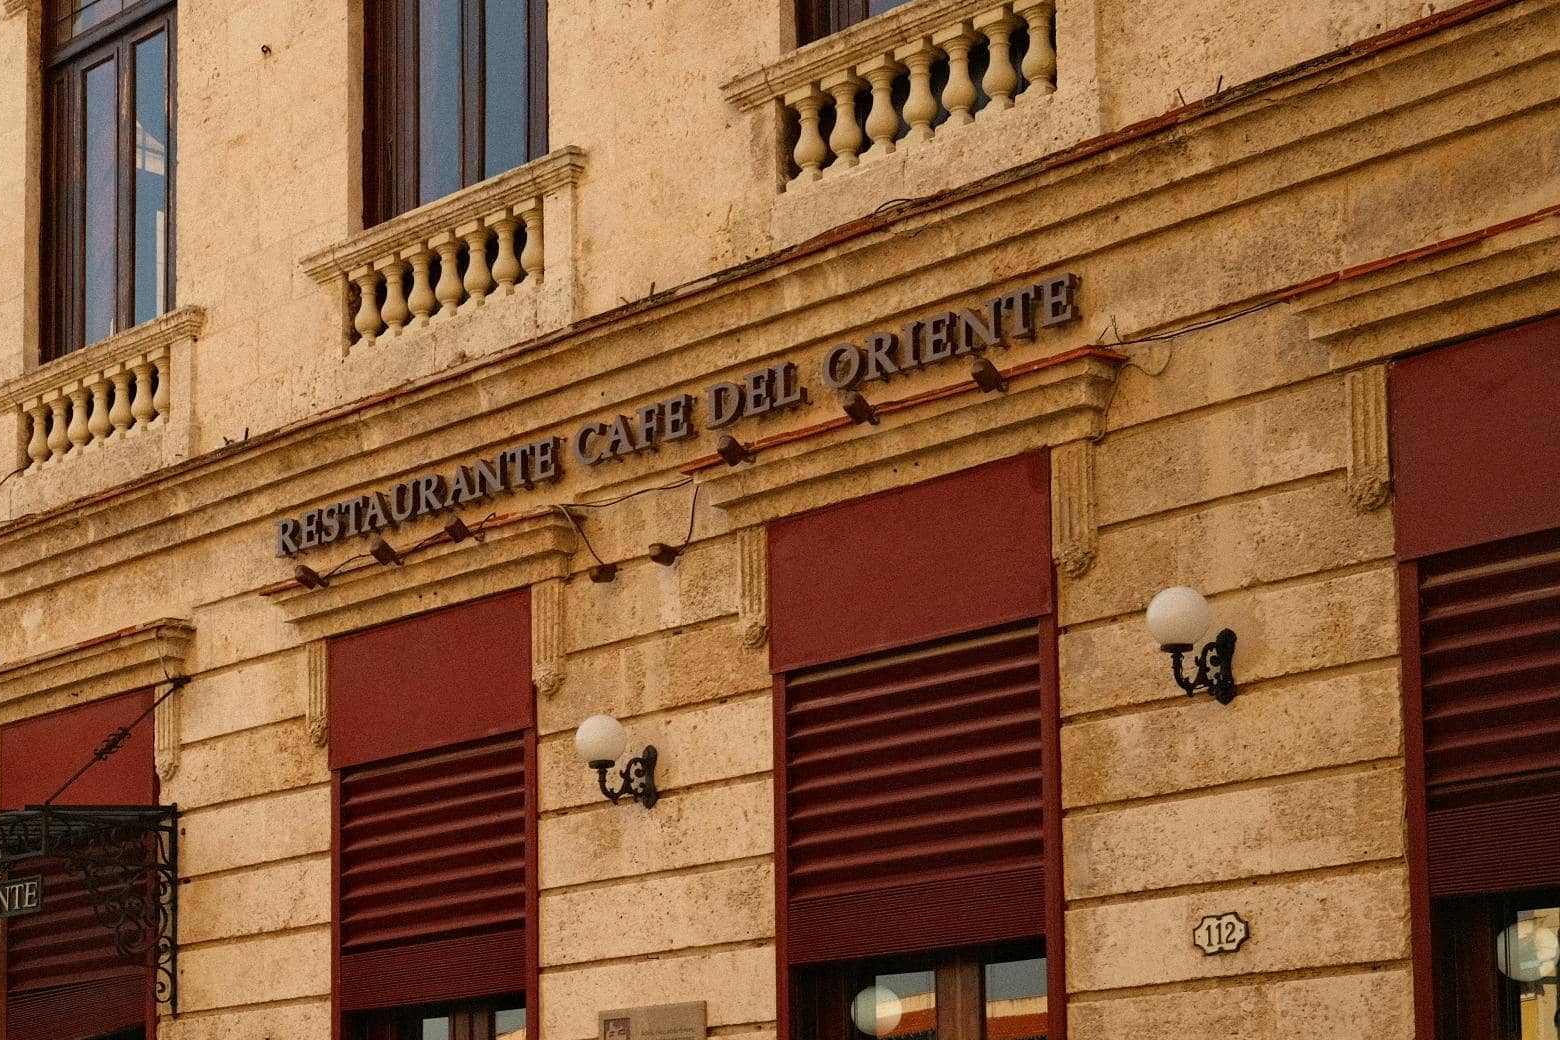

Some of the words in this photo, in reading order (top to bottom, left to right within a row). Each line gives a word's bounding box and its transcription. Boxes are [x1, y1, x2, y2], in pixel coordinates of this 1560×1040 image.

[274, 437, 558, 558] RESTAURANTE
[574, 394, 692, 466] CAFE
[706, 362, 808, 430] DEL
[821, 272, 1078, 390] ORIENTE
[1206, 921, 1236, 947] 112
